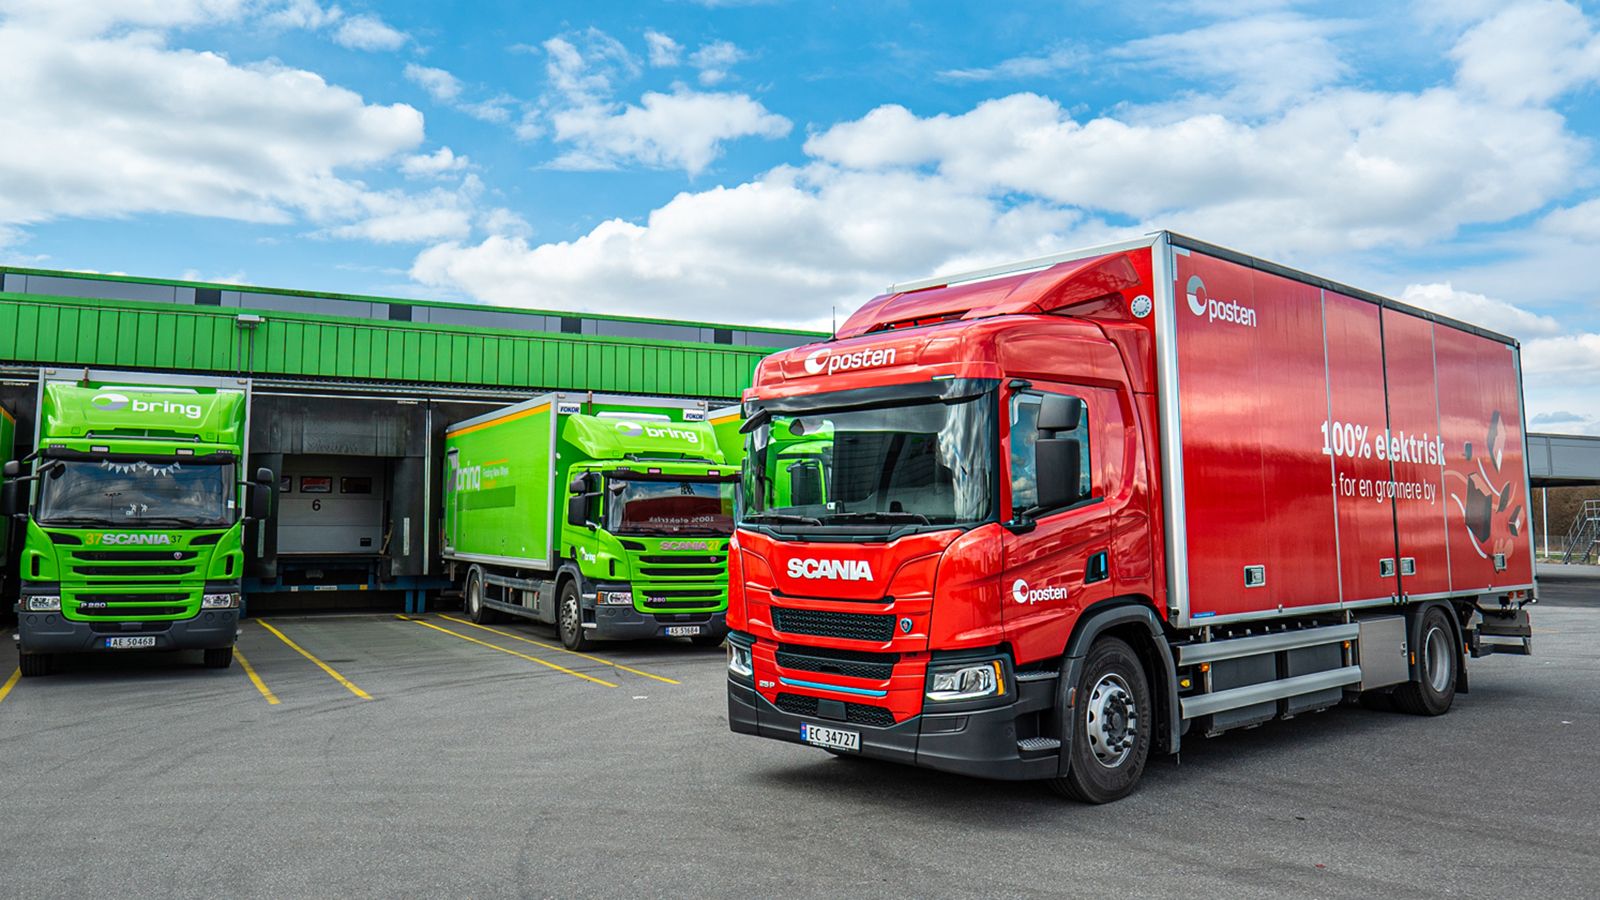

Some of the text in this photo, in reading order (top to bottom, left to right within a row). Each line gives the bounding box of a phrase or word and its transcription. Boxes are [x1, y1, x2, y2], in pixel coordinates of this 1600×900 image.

[1208, 299, 1257, 328] posten
[827, 347, 896, 376] posten
[132, 399, 202, 419] bring
[646, 427, 698, 443] bring
[1321, 420, 1446, 466] 100% elektrisk
[1339, 472, 1356, 497] for
[1359, 478, 1373, 497] en
[1375, 479, 1422, 503] grønnere
[1423, 478, 1436, 505] by
[312, 499, 321, 511] 6
[85, 533, 182, 545] 37 SCANIA 37
[660, 540, 720, 551] SCANIA 27
[787, 557, 874, 582] SCANIA
[1030, 585, 1068, 605] posten
[112, 637, 153, 646] AE 50468
[809, 727, 821, 741] EC
[825, 730, 857, 747] 34727
